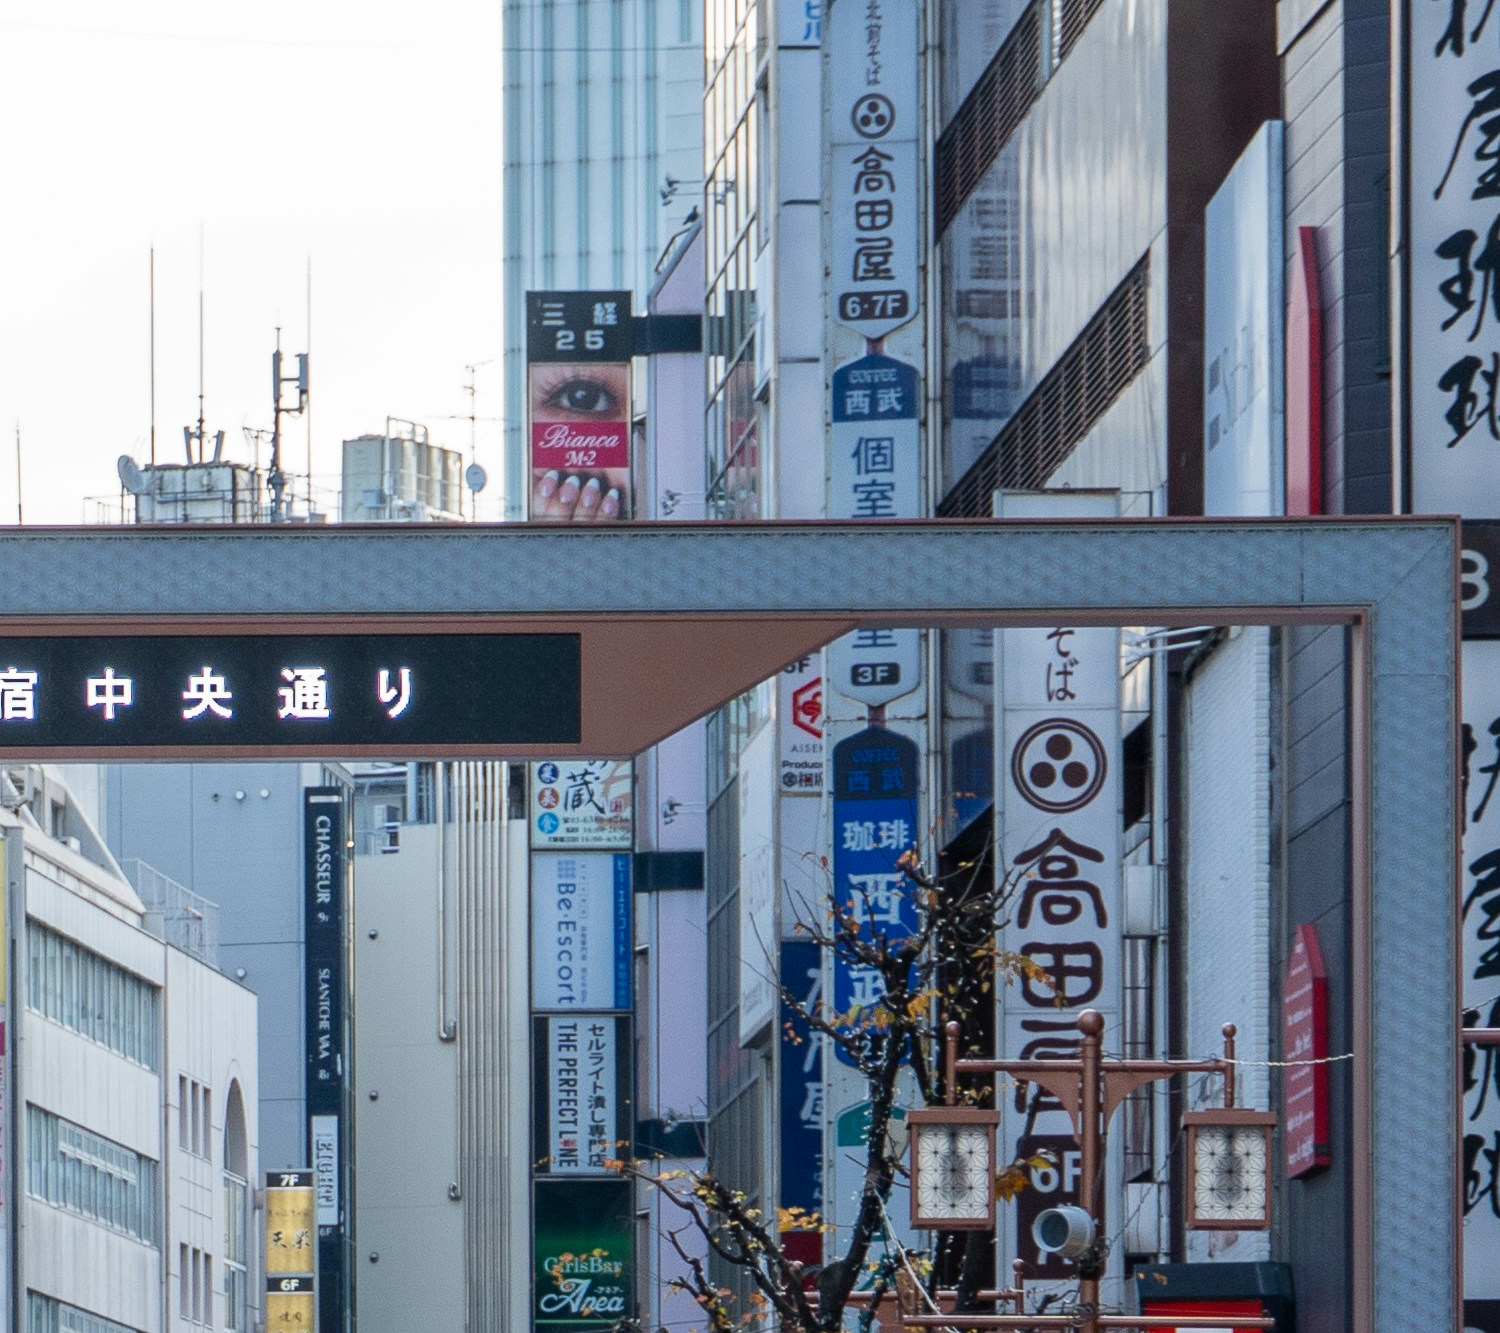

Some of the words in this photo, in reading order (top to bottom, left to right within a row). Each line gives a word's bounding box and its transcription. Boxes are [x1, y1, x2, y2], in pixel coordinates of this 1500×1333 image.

[851, 146, 896, 282] 高田屋
[846, 388, 903, 415] 西武
[540, 423, 620, 449] Bianca
[856, 665, 889, 683] 3F
[781, 760, 823, 769] Produc
[842, 820, 910, 850] 珈琲
[558, 1057, 578, 1118] PERFECT
[279, 1174, 299, 1187] 7F
[279, 1279, 300, 1291] 6F
